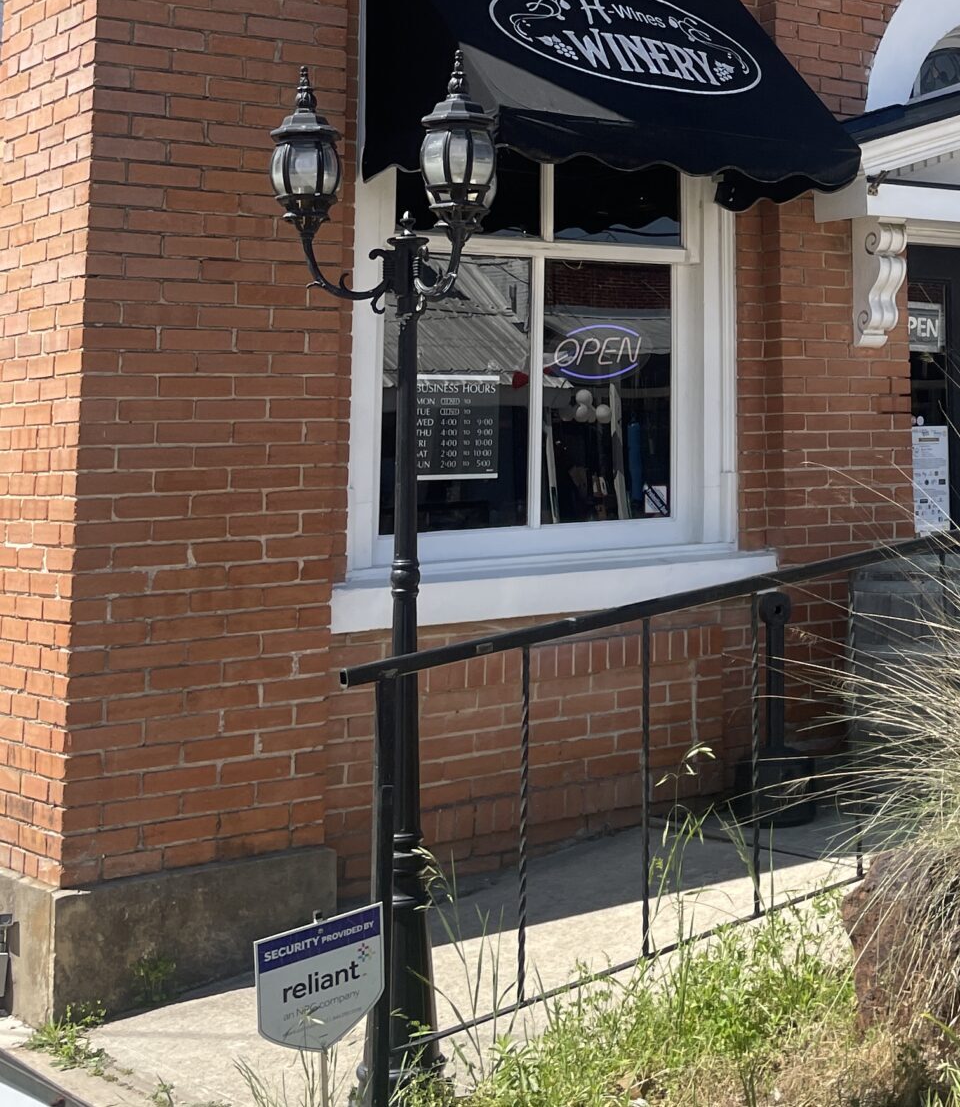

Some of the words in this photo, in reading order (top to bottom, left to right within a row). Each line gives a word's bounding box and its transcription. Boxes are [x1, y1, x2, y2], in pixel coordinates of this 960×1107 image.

[562, 28, 721, 86] WINERY
[908, 317, 939, 339] PEN
[554, 337, 642, 367] OPEN
[462, 383, 496, 394] HOURS
[418, 439, 426, 447] RI
[417, 460, 430, 468] UN
[264, 936, 320, 962] SECURITY
[321, 925, 363, 944] PROVIDED
[363, 920, 374, 931] BY
[283, 961, 360, 1003] reliant
[283, 1012, 295, 1022] an
[319, 989, 360, 1009] company
